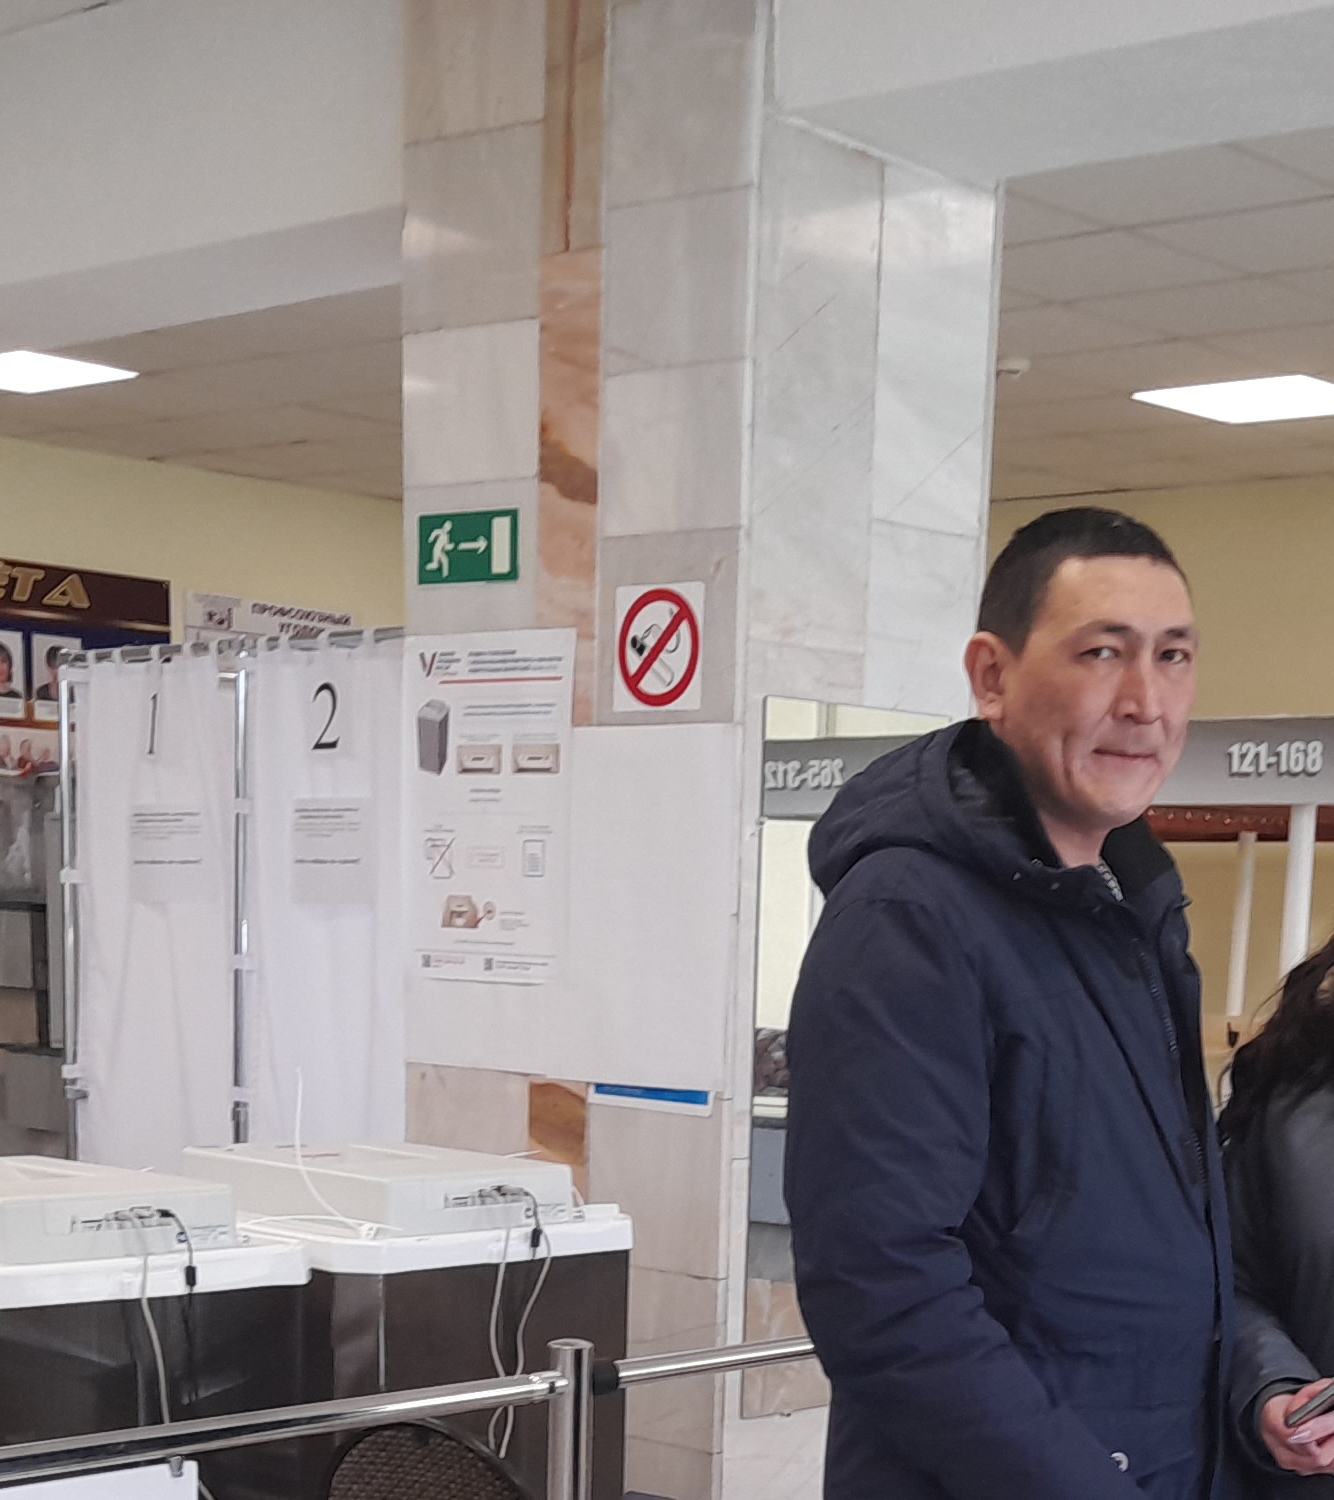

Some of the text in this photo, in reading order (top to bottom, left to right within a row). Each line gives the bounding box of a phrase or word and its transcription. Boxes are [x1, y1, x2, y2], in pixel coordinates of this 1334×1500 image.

[147, 692, 158, 755] 1
[310, 682, 341, 751] 2
[1227, 740, 1324, 774] 121-168
